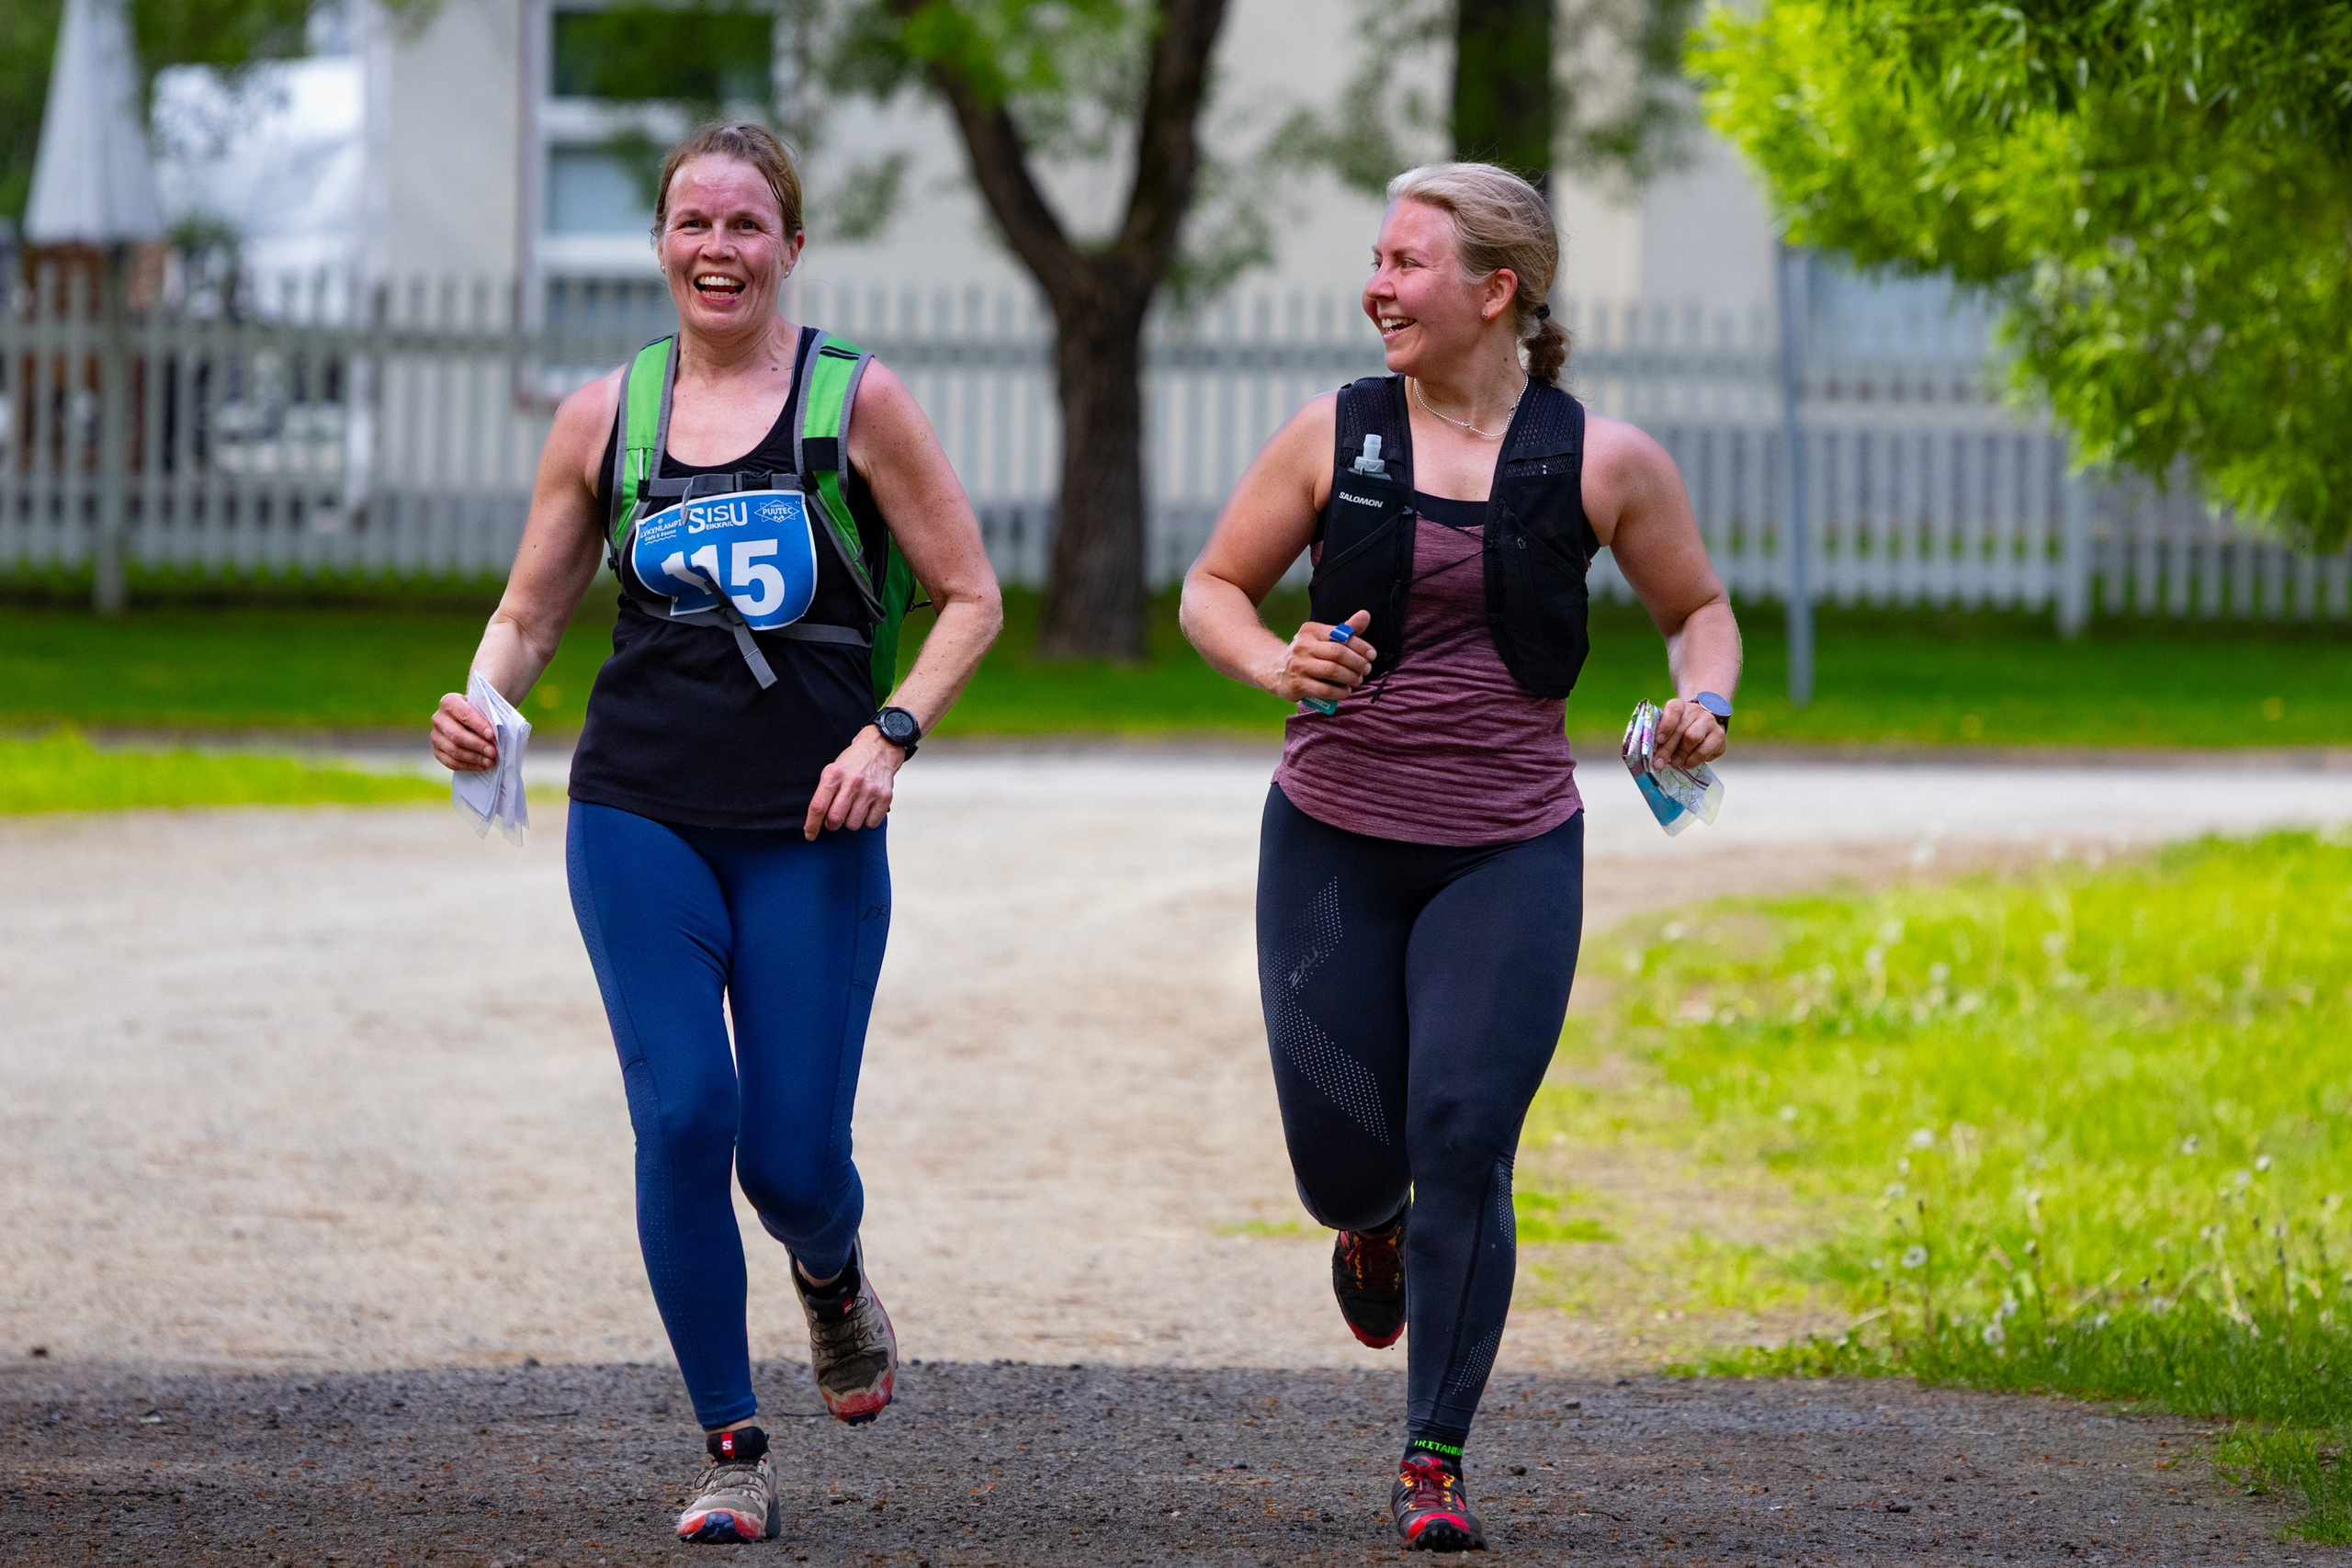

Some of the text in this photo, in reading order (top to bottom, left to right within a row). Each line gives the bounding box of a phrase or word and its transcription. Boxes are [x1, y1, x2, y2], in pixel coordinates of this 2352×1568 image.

[763, 507, 793, 515] PUUTEC
[1339, 491, 1384, 508] SALOMON
[688, 501, 748, 534] SISU
[661, 538, 786, 616] 115
